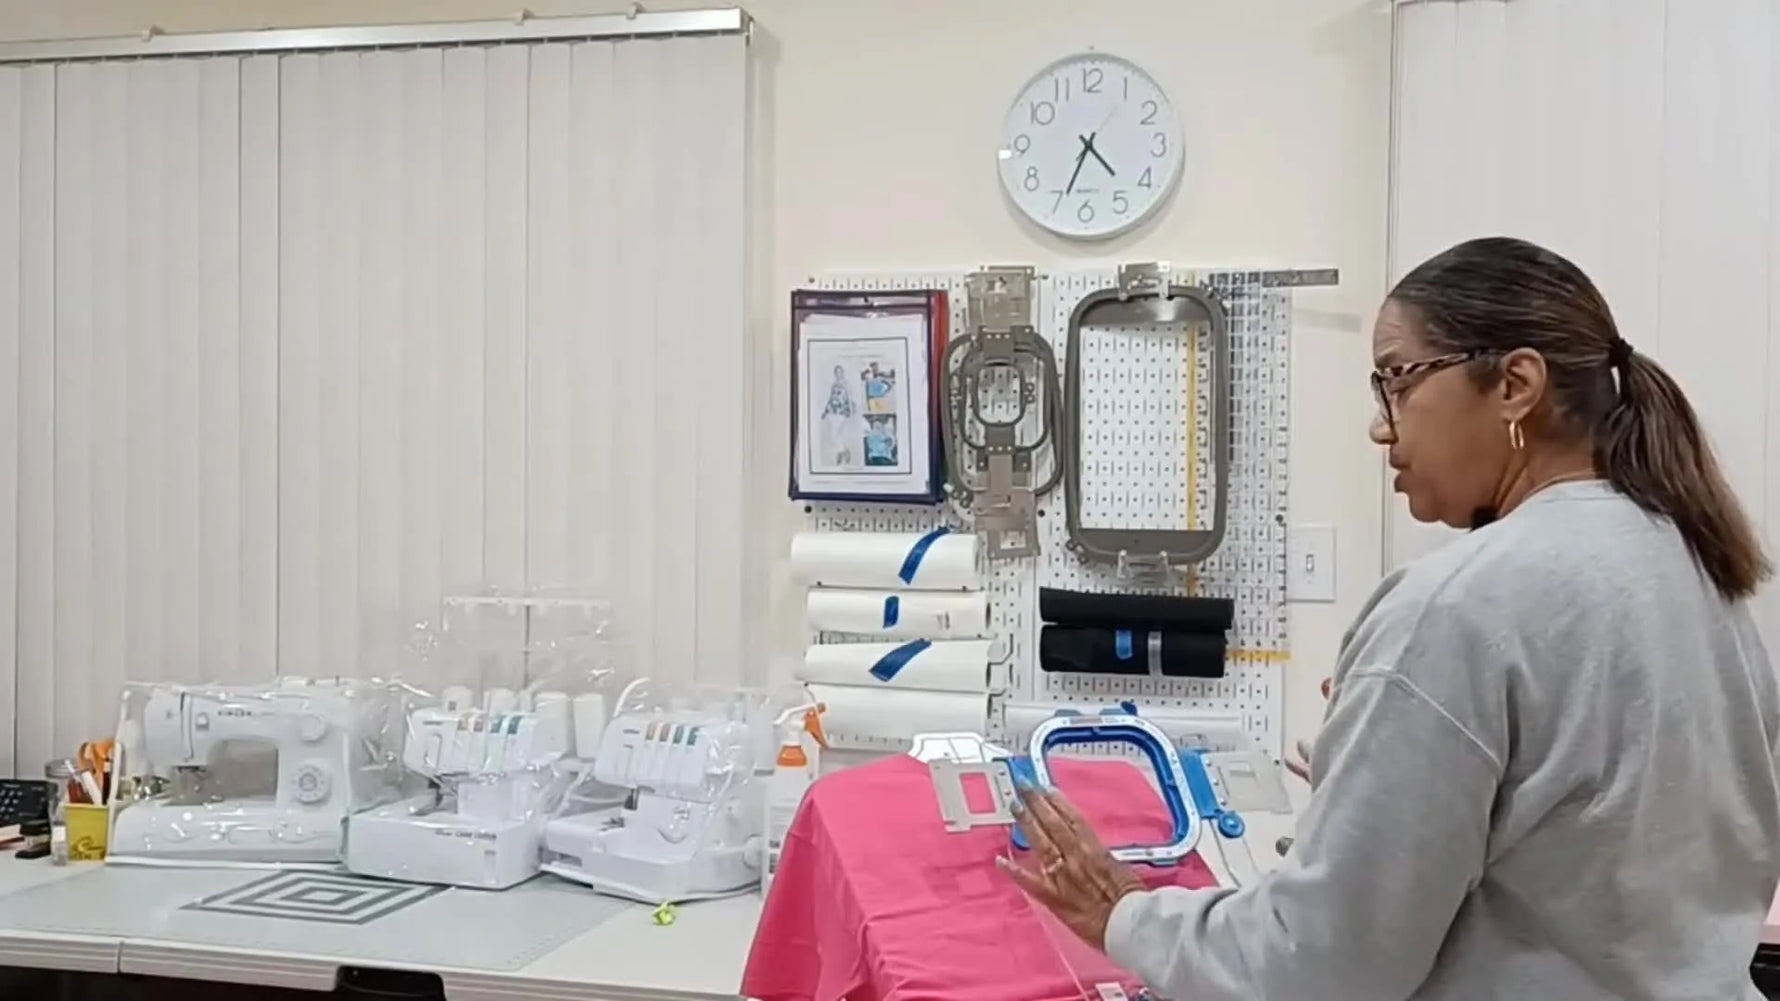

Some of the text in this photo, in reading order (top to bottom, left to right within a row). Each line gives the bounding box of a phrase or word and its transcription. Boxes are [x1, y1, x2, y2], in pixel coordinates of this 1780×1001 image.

[1055, 77, 1070, 102] 11
[1083, 68, 1103, 93] 12
[1030, 101, 1056, 126] 10
[1140, 100, 1158, 125] 2
[1014, 134, 1031, 158] 9
[1150, 132, 1167, 158] 3
[1024, 166, 1040, 192] 8
[1137, 166, 1152, 190] 4
[1050, 190, 1064, 215] 7
[1077, 200, 1095, 223] 6
[1112, 190, 1129, 215] 5
